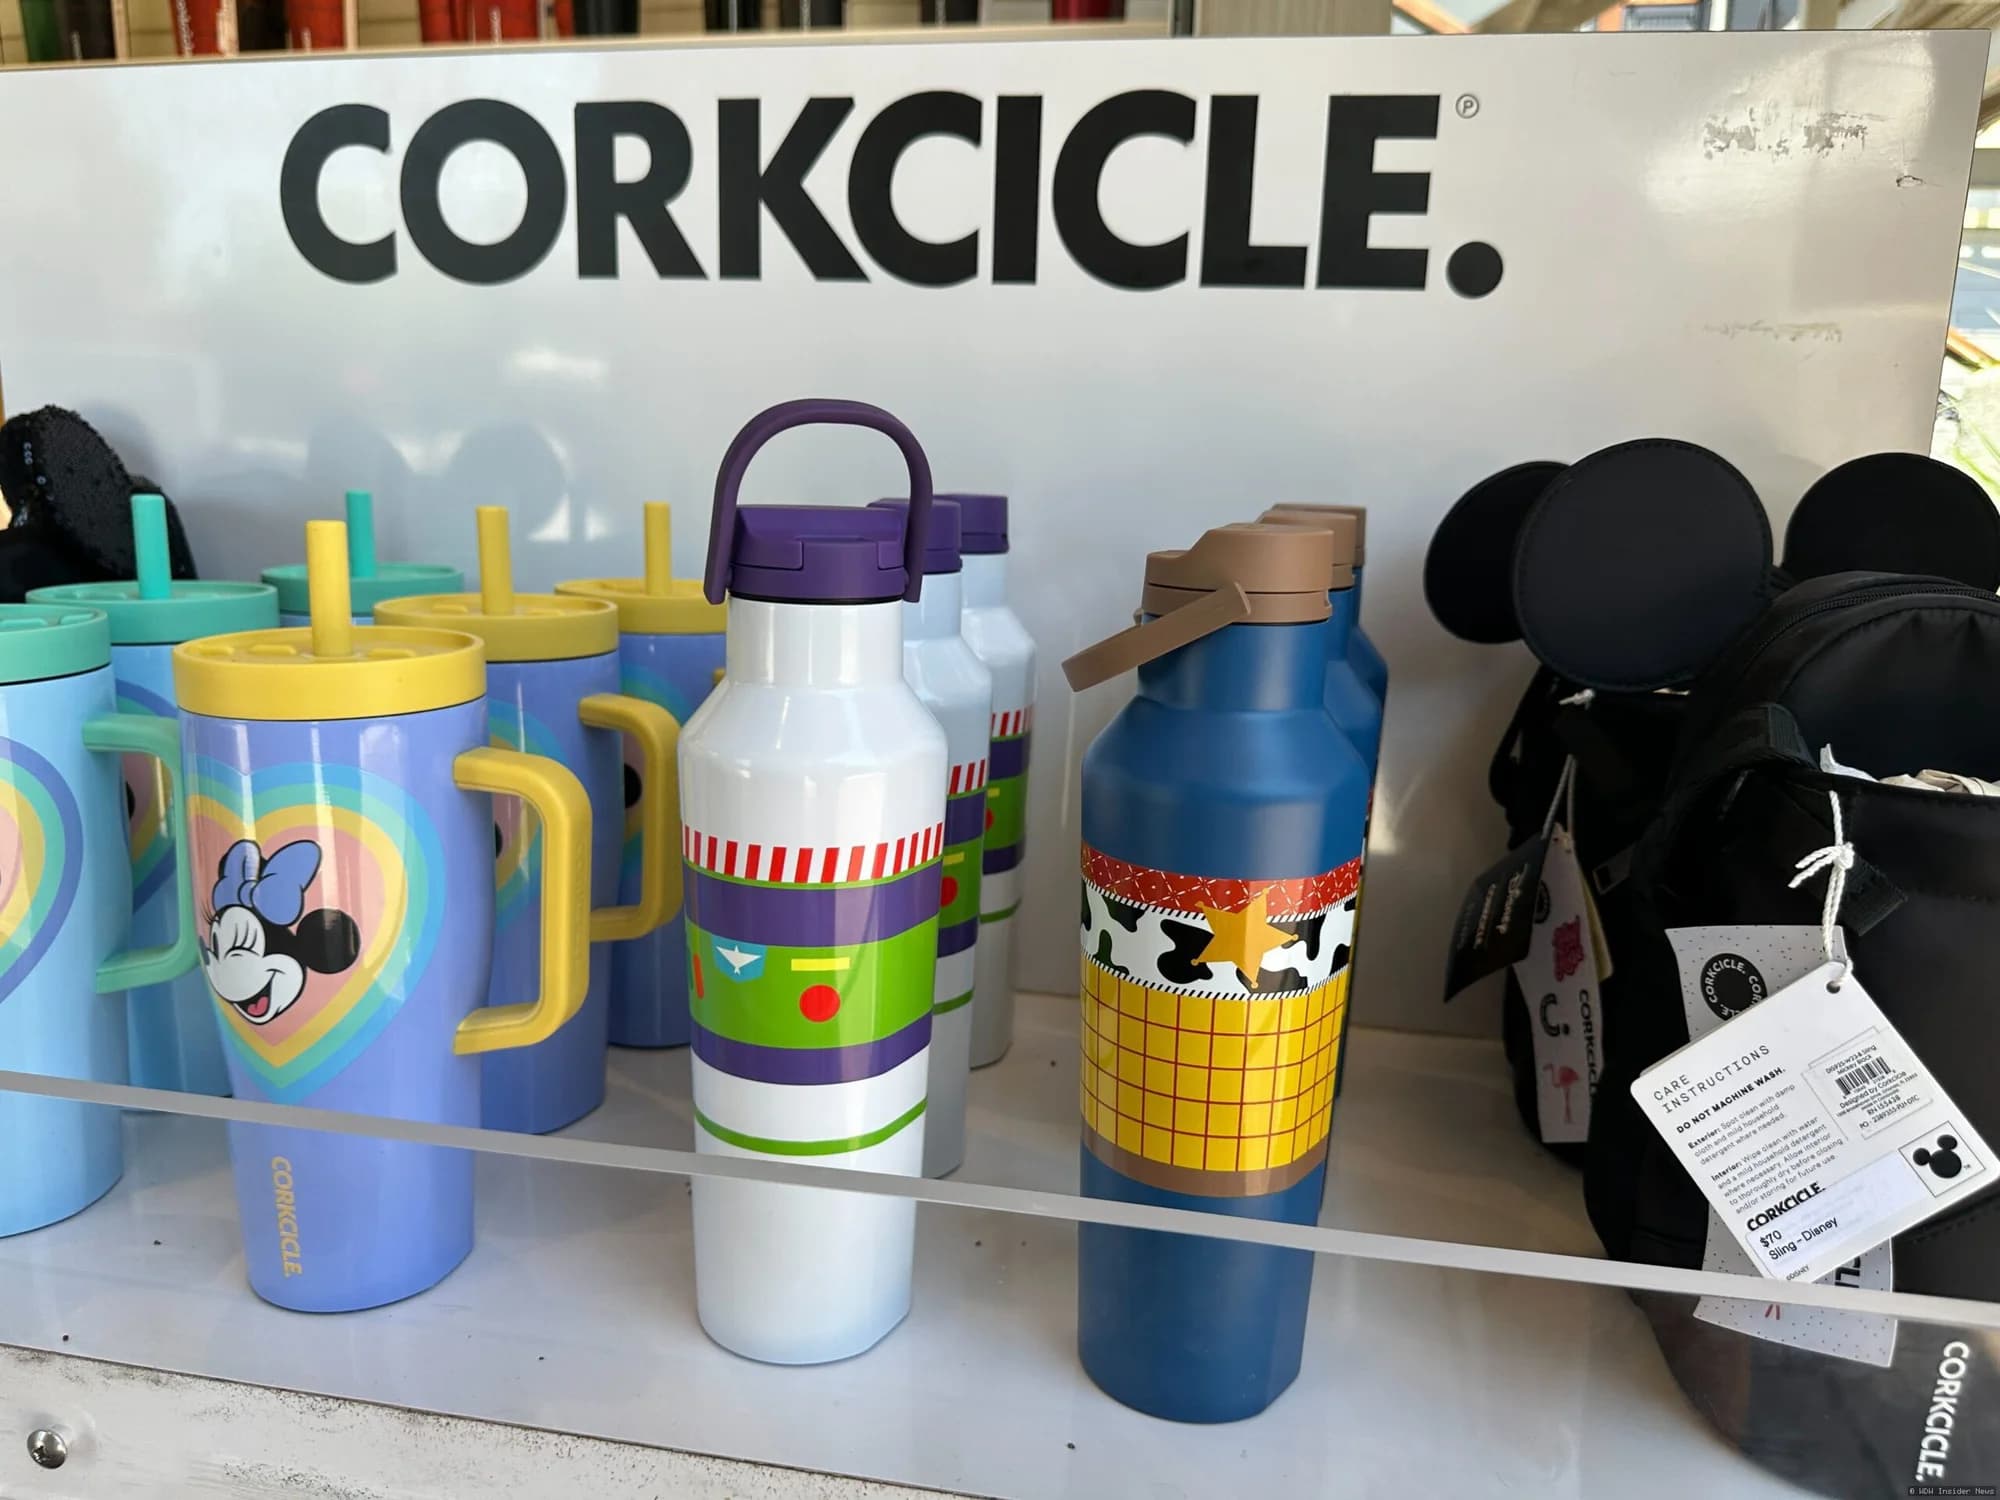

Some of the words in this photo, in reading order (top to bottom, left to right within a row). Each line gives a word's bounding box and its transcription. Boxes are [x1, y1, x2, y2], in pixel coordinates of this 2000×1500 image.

[280, 88, 1504, 300] CORKCICLE.
[1653, 1074, 1690, 1101] CARE
[1662, 1045, 1770, 1114] INSTRUCTIONS
[1676, 1122, 1691, 1134] DO
[1691, 1109, 1711, 1125] NOT
[1712, 1084, 1755, 1112] MACHINE
[1754, 1067, 1785, 1087] WASH.
[1688, 1128, 1721, 1149] Exterior:
[1720, 1117, 1739, 1130] Spot
[1739, 1105, 1759, 1119] clean
[1759, 1096, 1775, 1108] with
[1694, 1144, 1714, 1158] cloth
[1714, 1135, 1727, 1146] and
[1727, 1125, 1743, 1138] mild
[1742, 1103, 1780, 1128] household
[1700, 1142, 1736, 1165] detergent
[1711, 1162, 1742, 1181] Interior:
[1741, 1150, 1761, 1163] Wipe
[1762, 1138, 1782, 1152] clean
[1782, 1129, 1798, 1141] with
[1718, 1178, 1732, 1190] and
[1737, 1165, 1753, 1178] mild
[1752, 1144, 1790, 1169] household
[1790, 1124, 1827, 1147] detergent
[1724, 1183, 1746, 1198] where
[1784, 1149, 1804, 1163] Allow
[1803, 1133, 1831, 1151] interior
[1729, 1198, 1738, 1206] to
[1738, 1176, 1777, 1201] thoroughly
[1778, 1168, 1791, 1178] dry
[1790, 1154, 1816, 1170] before
[1816, 1138, 1844, 1156] closing
[1747, 1182, 1826, 1232] CORKCICLE.
[1760, 1183, 1787, 1200] storing
[1785, 1175, 1797, 1185] for
[1797, 1163, 1822, 1178] future
[1760, 1230, 1782, 1248] $70
[1769, 1241, 1798, 1260] Sling
[1801, 1217, 1838, 1242] Disney
[1915, 1341, 1970, 1482] CORKCICLE.
